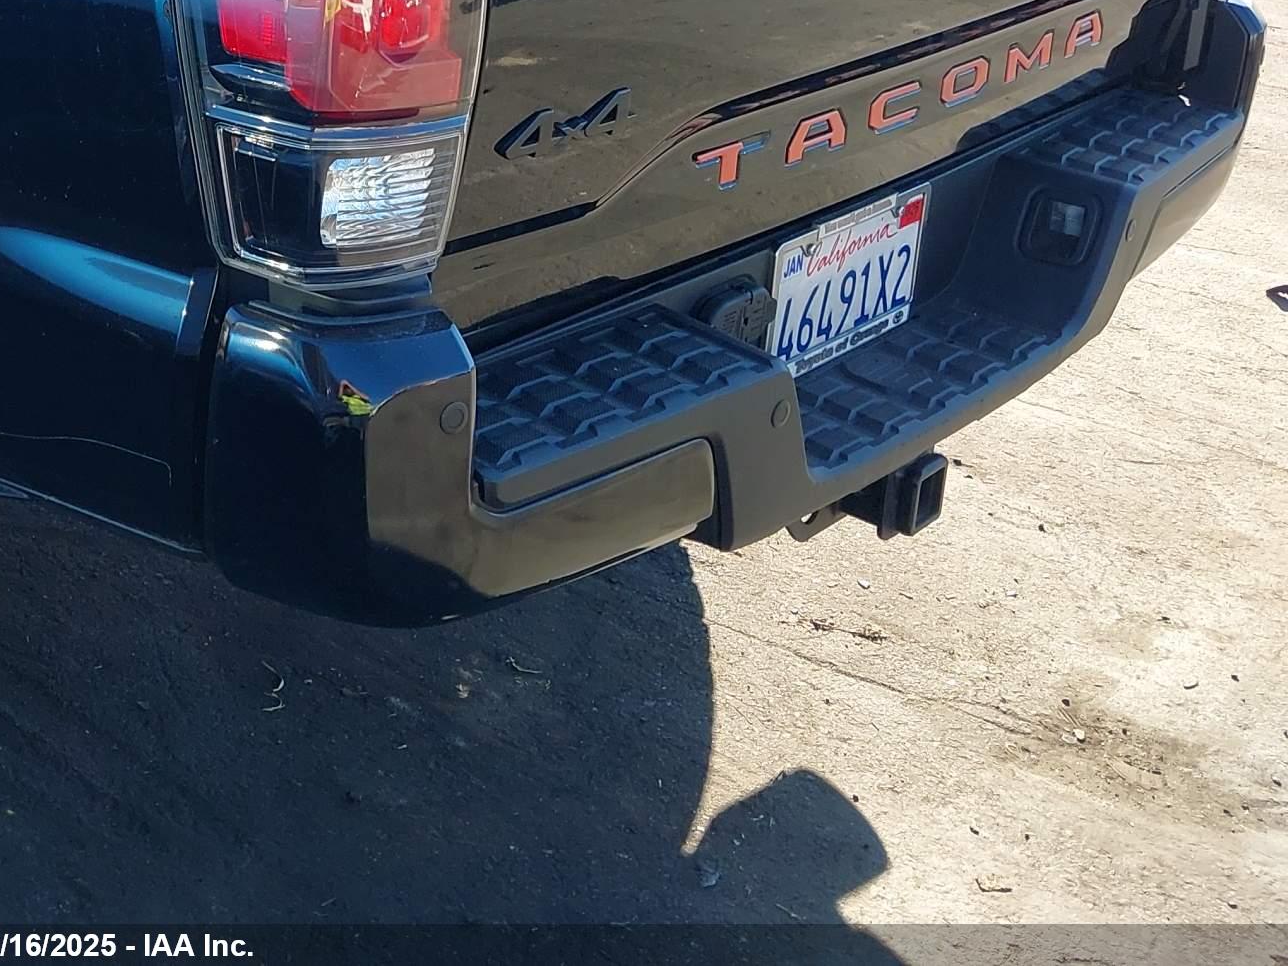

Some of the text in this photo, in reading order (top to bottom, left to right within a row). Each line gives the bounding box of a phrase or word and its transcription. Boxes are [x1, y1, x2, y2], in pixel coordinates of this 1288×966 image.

[692, 9, 1104, 191] TACOMA
[783, 252, 803, 278] JAN
[807, 222, 898, 277] California
[777, 244, 911, 361] 46491X2
